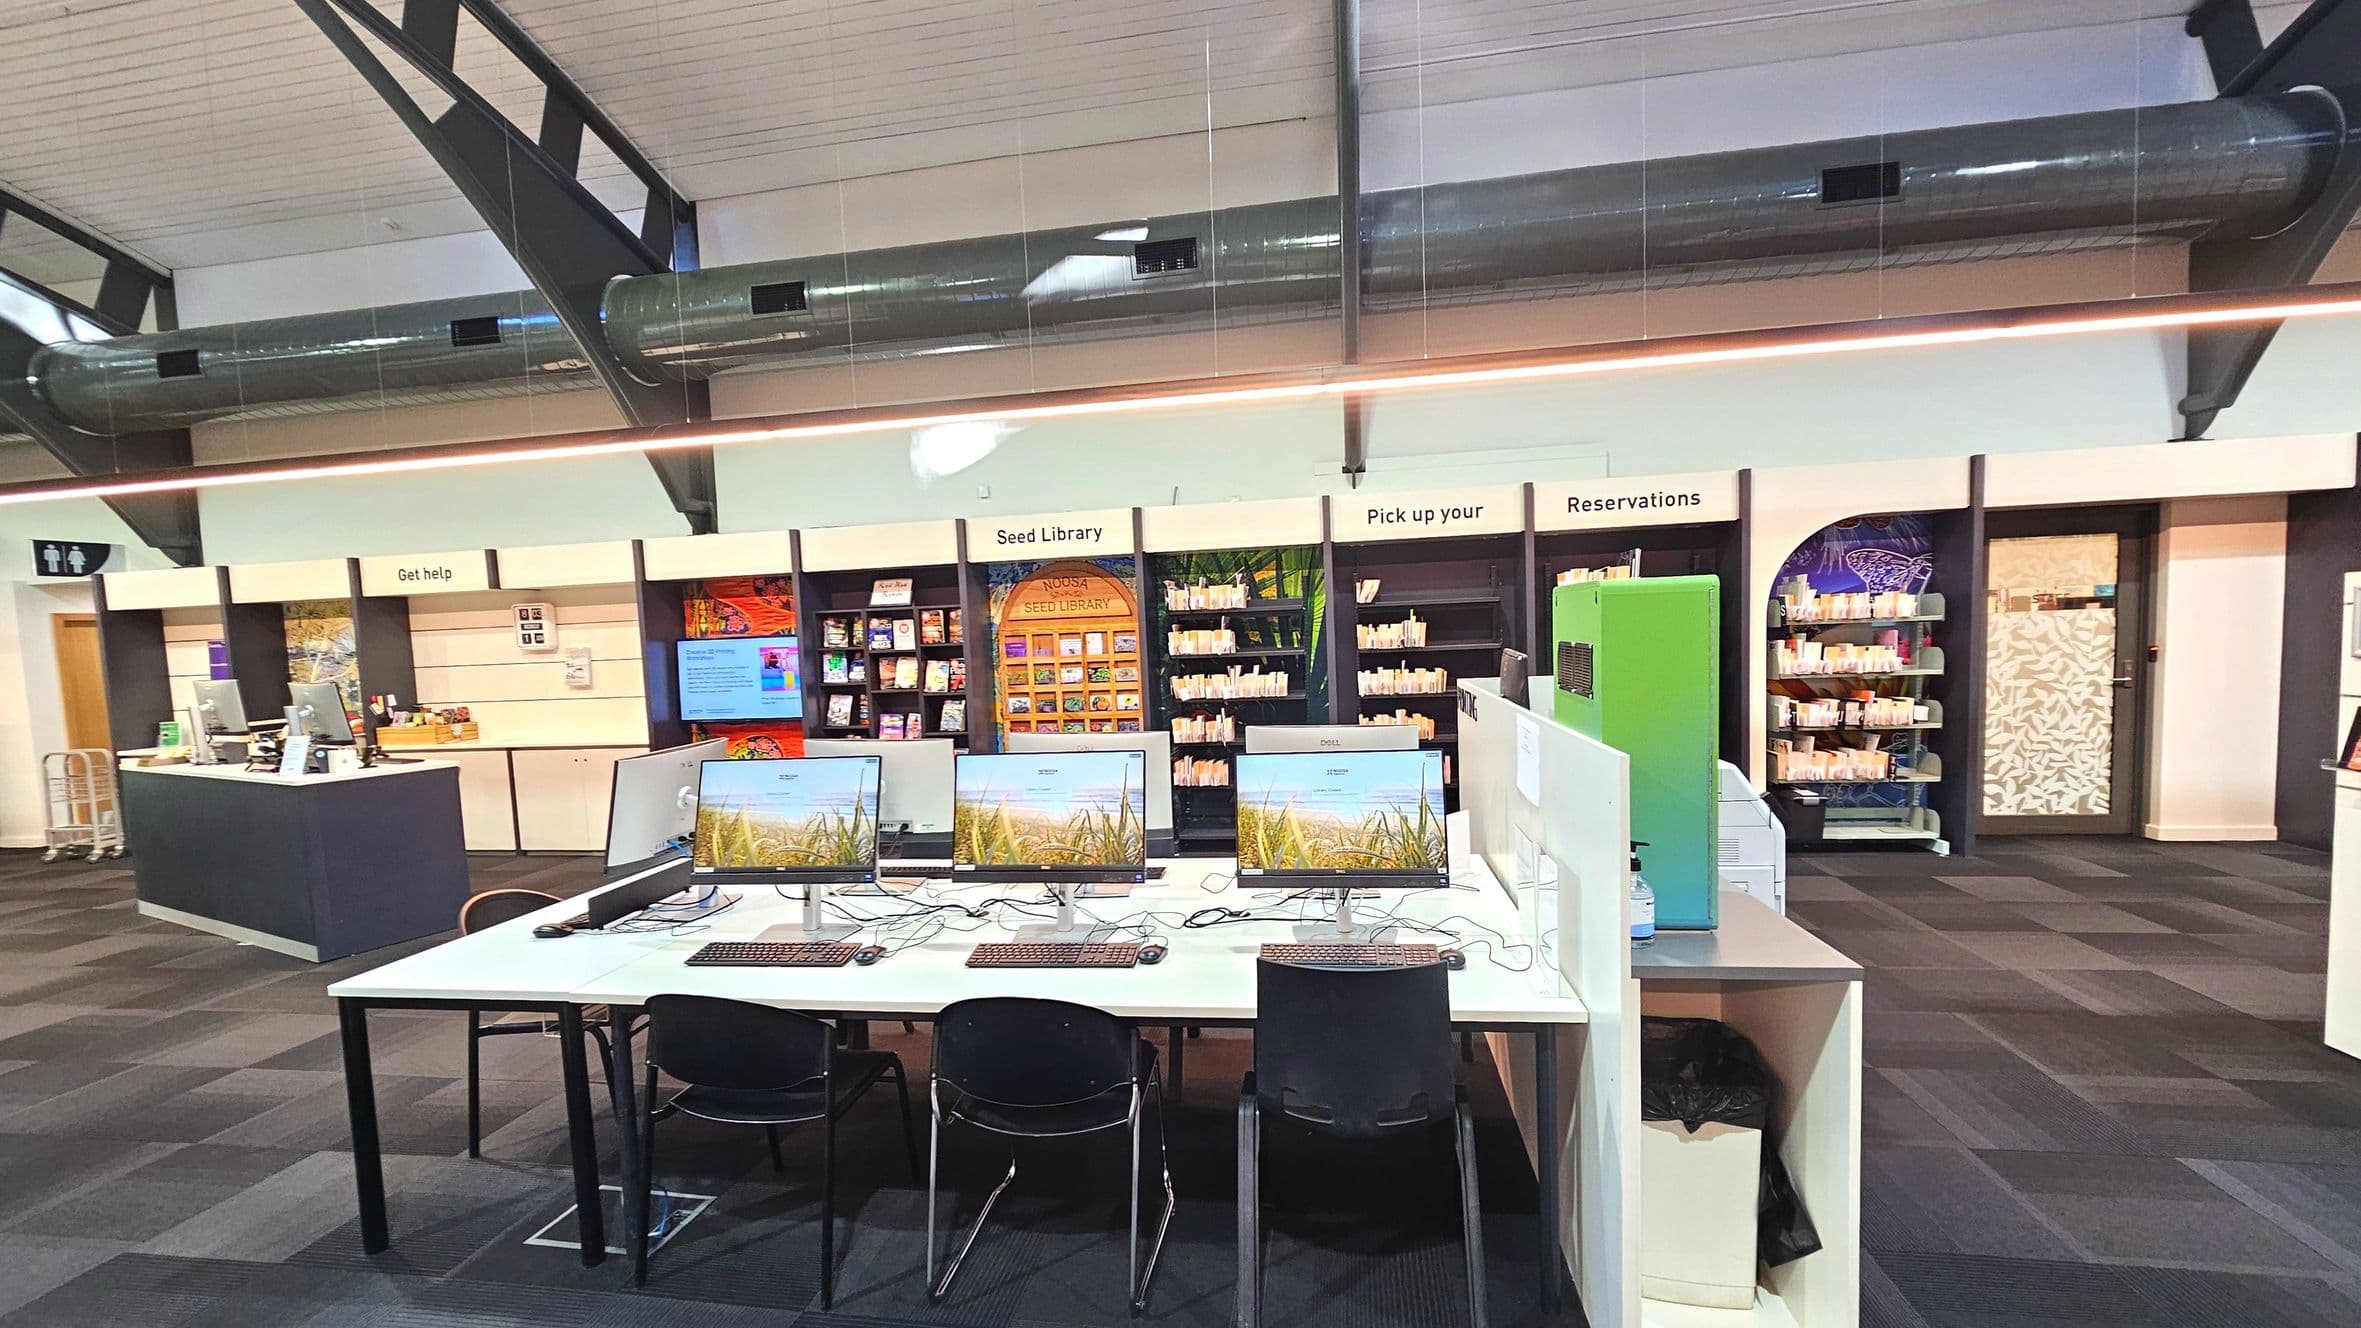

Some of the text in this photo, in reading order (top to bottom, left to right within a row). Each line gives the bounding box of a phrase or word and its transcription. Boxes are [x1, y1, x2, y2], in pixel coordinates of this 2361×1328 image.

[1567, 490, 1701, 513] Reservations
[1367, 505, 1484, 525] Pick up your
[997, 526, 1103, 545] Seed Library
[398, 566, 452, 582] Get help
[1042, 576, 1089, 592] NOOSA
[1024, 598, 1111, 613] SEED LIBRARY
